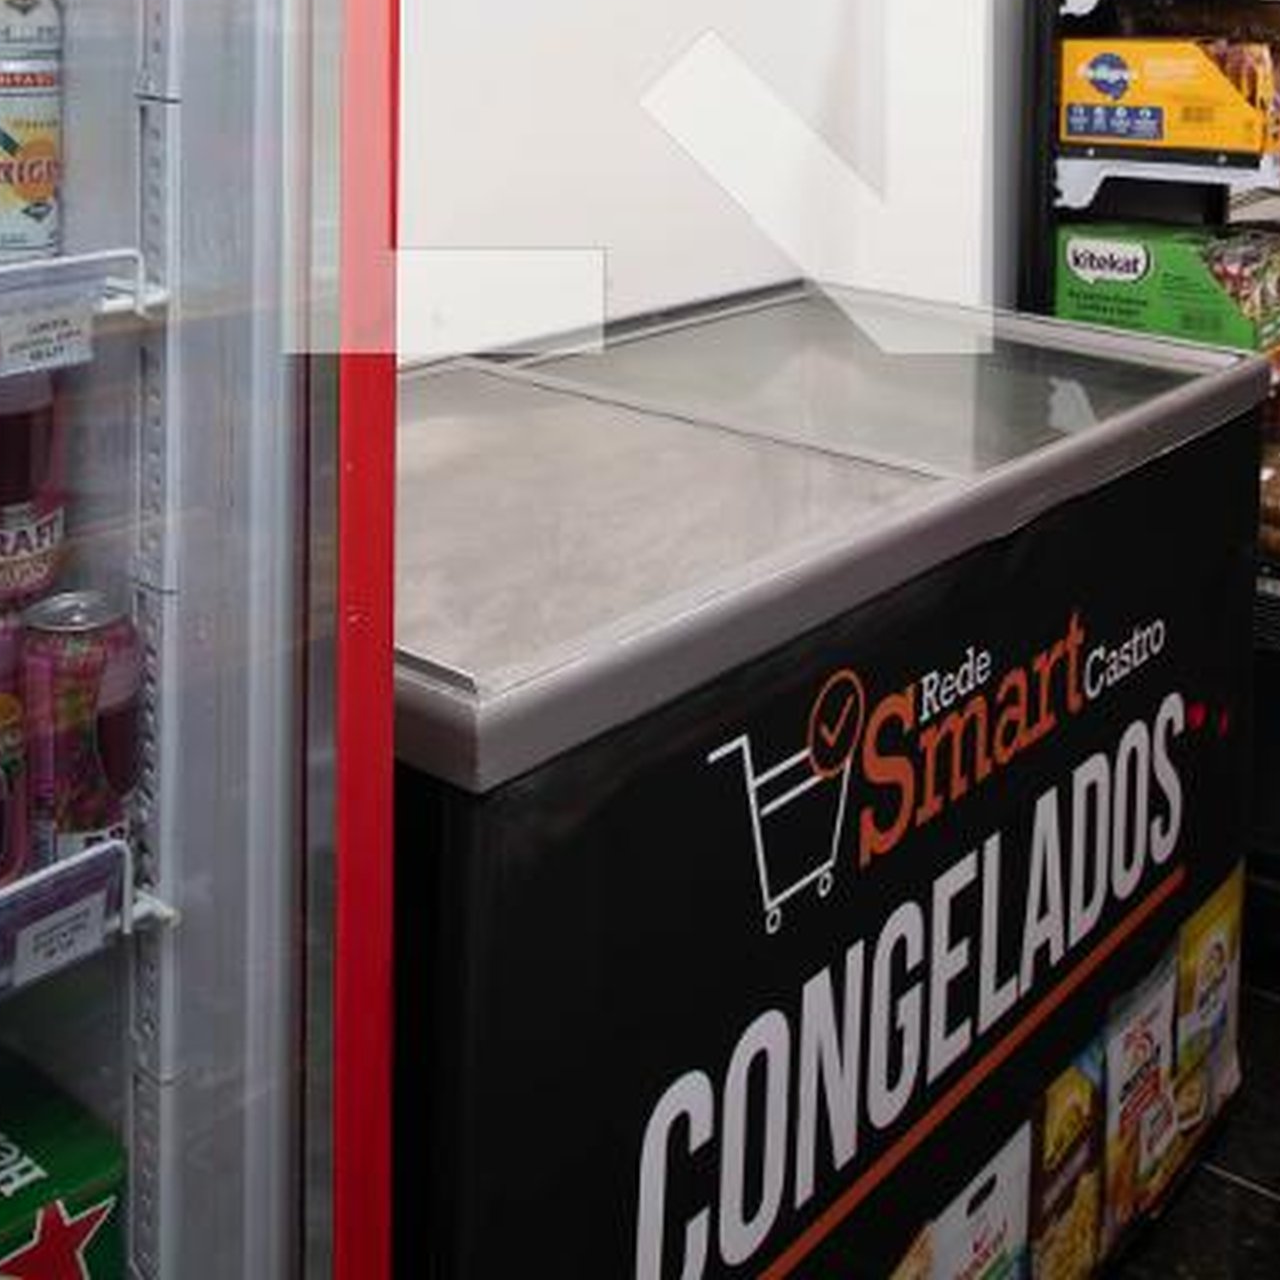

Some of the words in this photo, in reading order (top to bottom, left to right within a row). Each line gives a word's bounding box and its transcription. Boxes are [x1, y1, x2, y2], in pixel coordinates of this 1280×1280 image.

[1071, 248, 1141, 274] kitekat
[919, 647, 992, 719] Rede
[1084, 619, 1166, 700] Castro
[860, 613, 1088, 867] Smart
[635, 692, 1186, 1280] CONGELADOS
